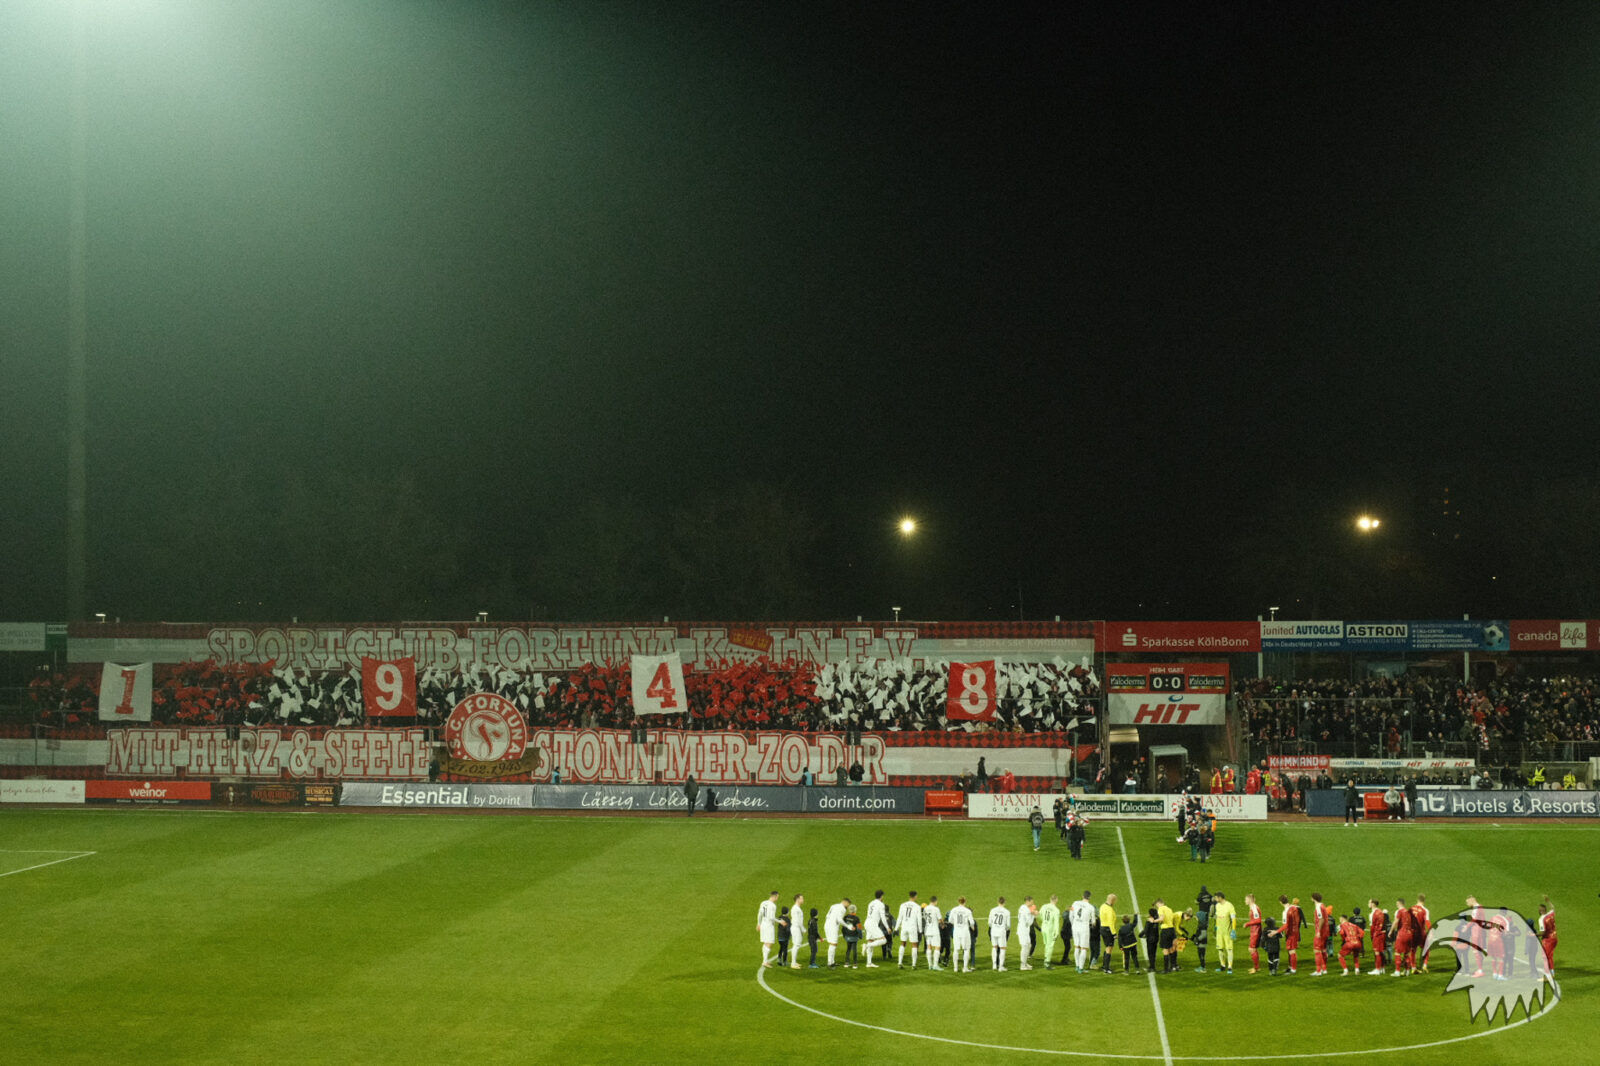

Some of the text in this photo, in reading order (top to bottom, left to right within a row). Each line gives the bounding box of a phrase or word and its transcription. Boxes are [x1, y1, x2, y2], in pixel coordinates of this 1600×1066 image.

[1263, 624, 1340, 636] junited AUTOGLAS
[1348, 626, 1407, 637] ASTRON
[1517, 627, 1586, 646] canada life
[206, 627, 460, 672] SPORTCLUB
[468, 627, 678, 672] FORTUNA
[1141, 636, 1249, 649] Sparkasse KölnBonn
[375, 664, 403, 710] 9
[646, 662, 677, 709] 4
[1110, 676, 1146, 687] Kaloderma
[1189, 676, 1225, 687] Kaloderma
[115, 670, 136, 714] 1
[960, 667, 988, 715] 8
[1134, 703, 1201, 723] HIT
[464, 696, 524, 754] FORTUNA
[105, 729, 430, 777] MIT HERZ & SEELE
[531, 730, 660, 783] STONN
[662, 731, 752, 784] MER
[756, 732, 810, 784] ZO
[129, 782, 167, 798] weinor
[381, 786, 521, 807] Essential by Dorint
[581, 791, 640, 810] Lässig.
[819, 795, 896, 809] dorint.com
[993, 794, 1041, 807] MAXIM
[1075, 801, 1117, 812] Kaloderma
[1121, 801, 1164, 812] Kaloderma
[1452, 797, 1507, 813] Hotels
[1512, 799, 1526, 813] &
[1531, 798, 1597, 815] Resorts
[994, 913, 1004, 925] 20
[1077, 908, 1083, 919] 4
